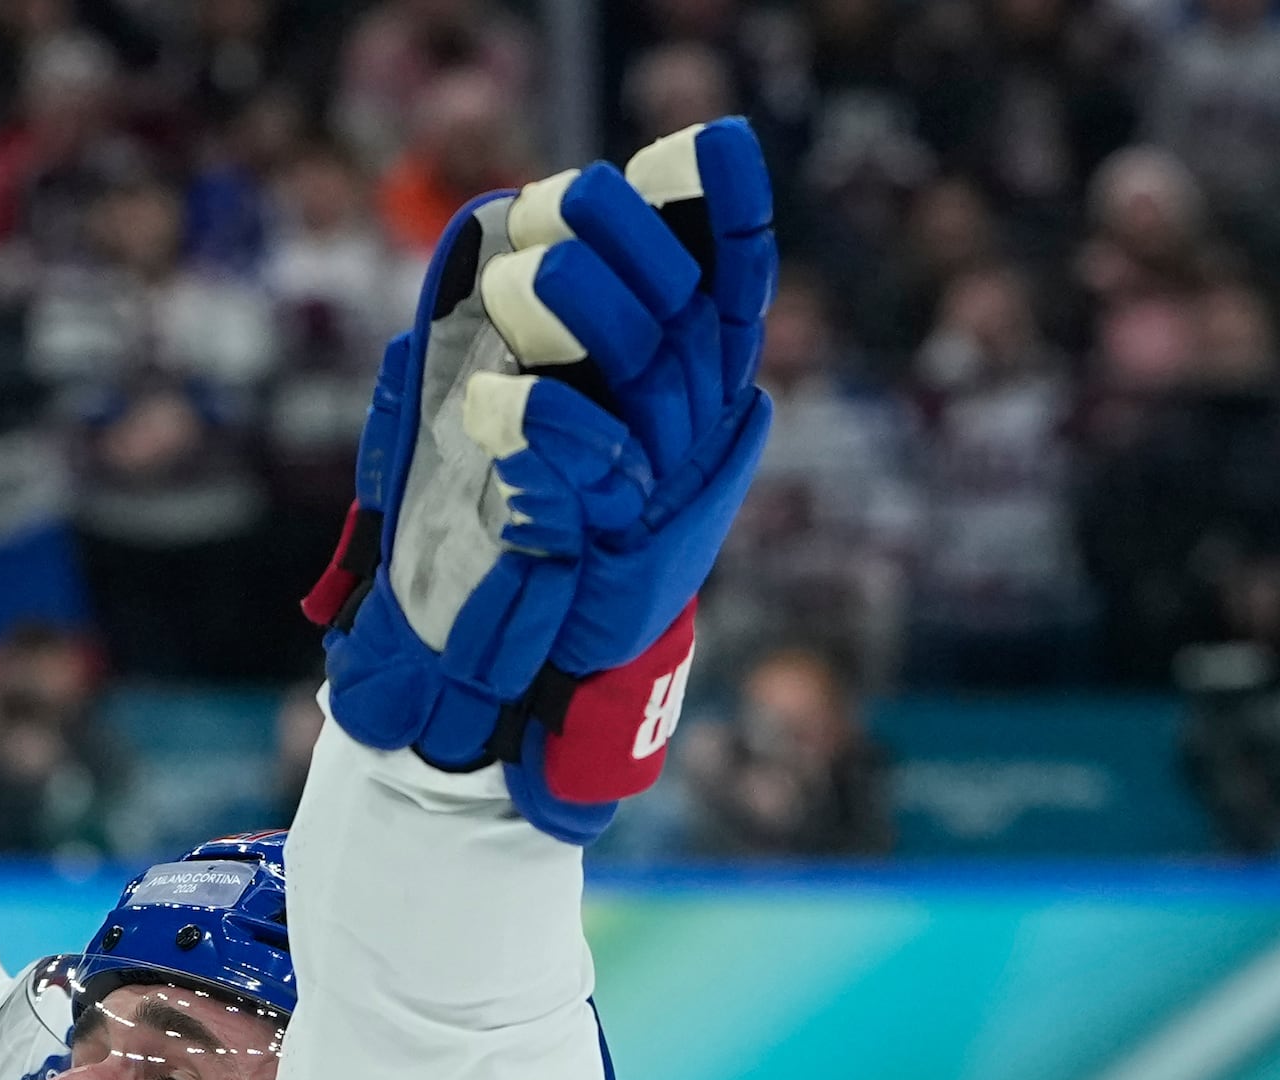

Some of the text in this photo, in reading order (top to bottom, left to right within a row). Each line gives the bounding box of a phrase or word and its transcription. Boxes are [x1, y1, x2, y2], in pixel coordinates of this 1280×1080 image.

[146, 871, 241, 888] MILANO CORTINA
[173, 884, 197, 894] 2026
